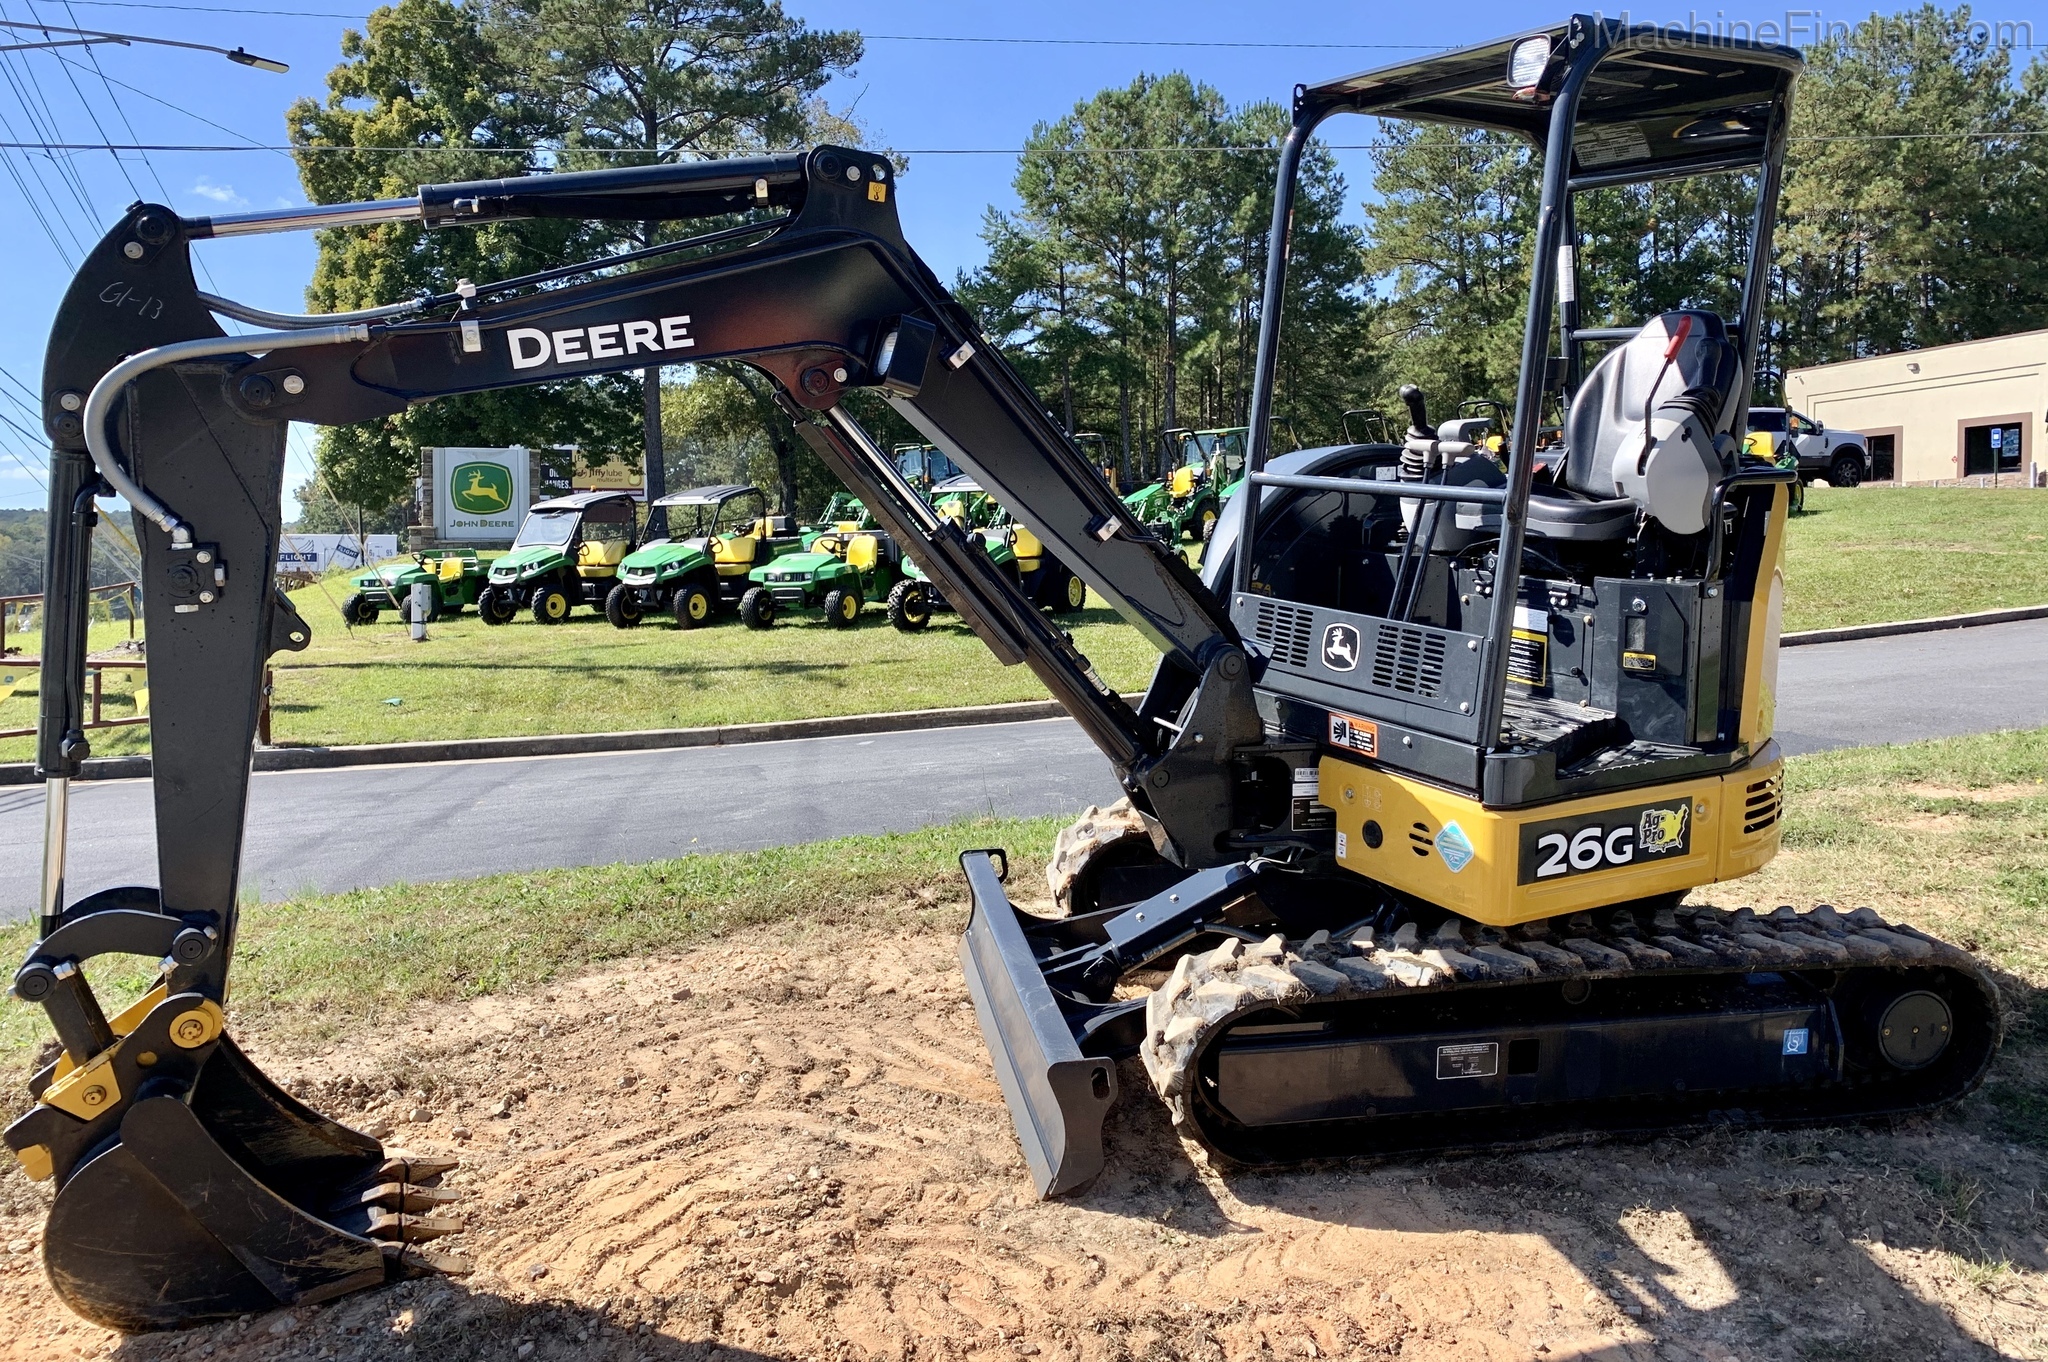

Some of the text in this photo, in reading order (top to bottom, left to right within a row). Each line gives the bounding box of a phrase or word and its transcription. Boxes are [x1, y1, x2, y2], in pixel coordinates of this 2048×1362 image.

[506, 315, 695, 370] DEERE
[606, 469, 623, 477] lube
[449, 519, 515, 528] JOHN DEERE
[1642, 829, 1665, 844] Pro
[1536, 826, 1634, 878] 26G
